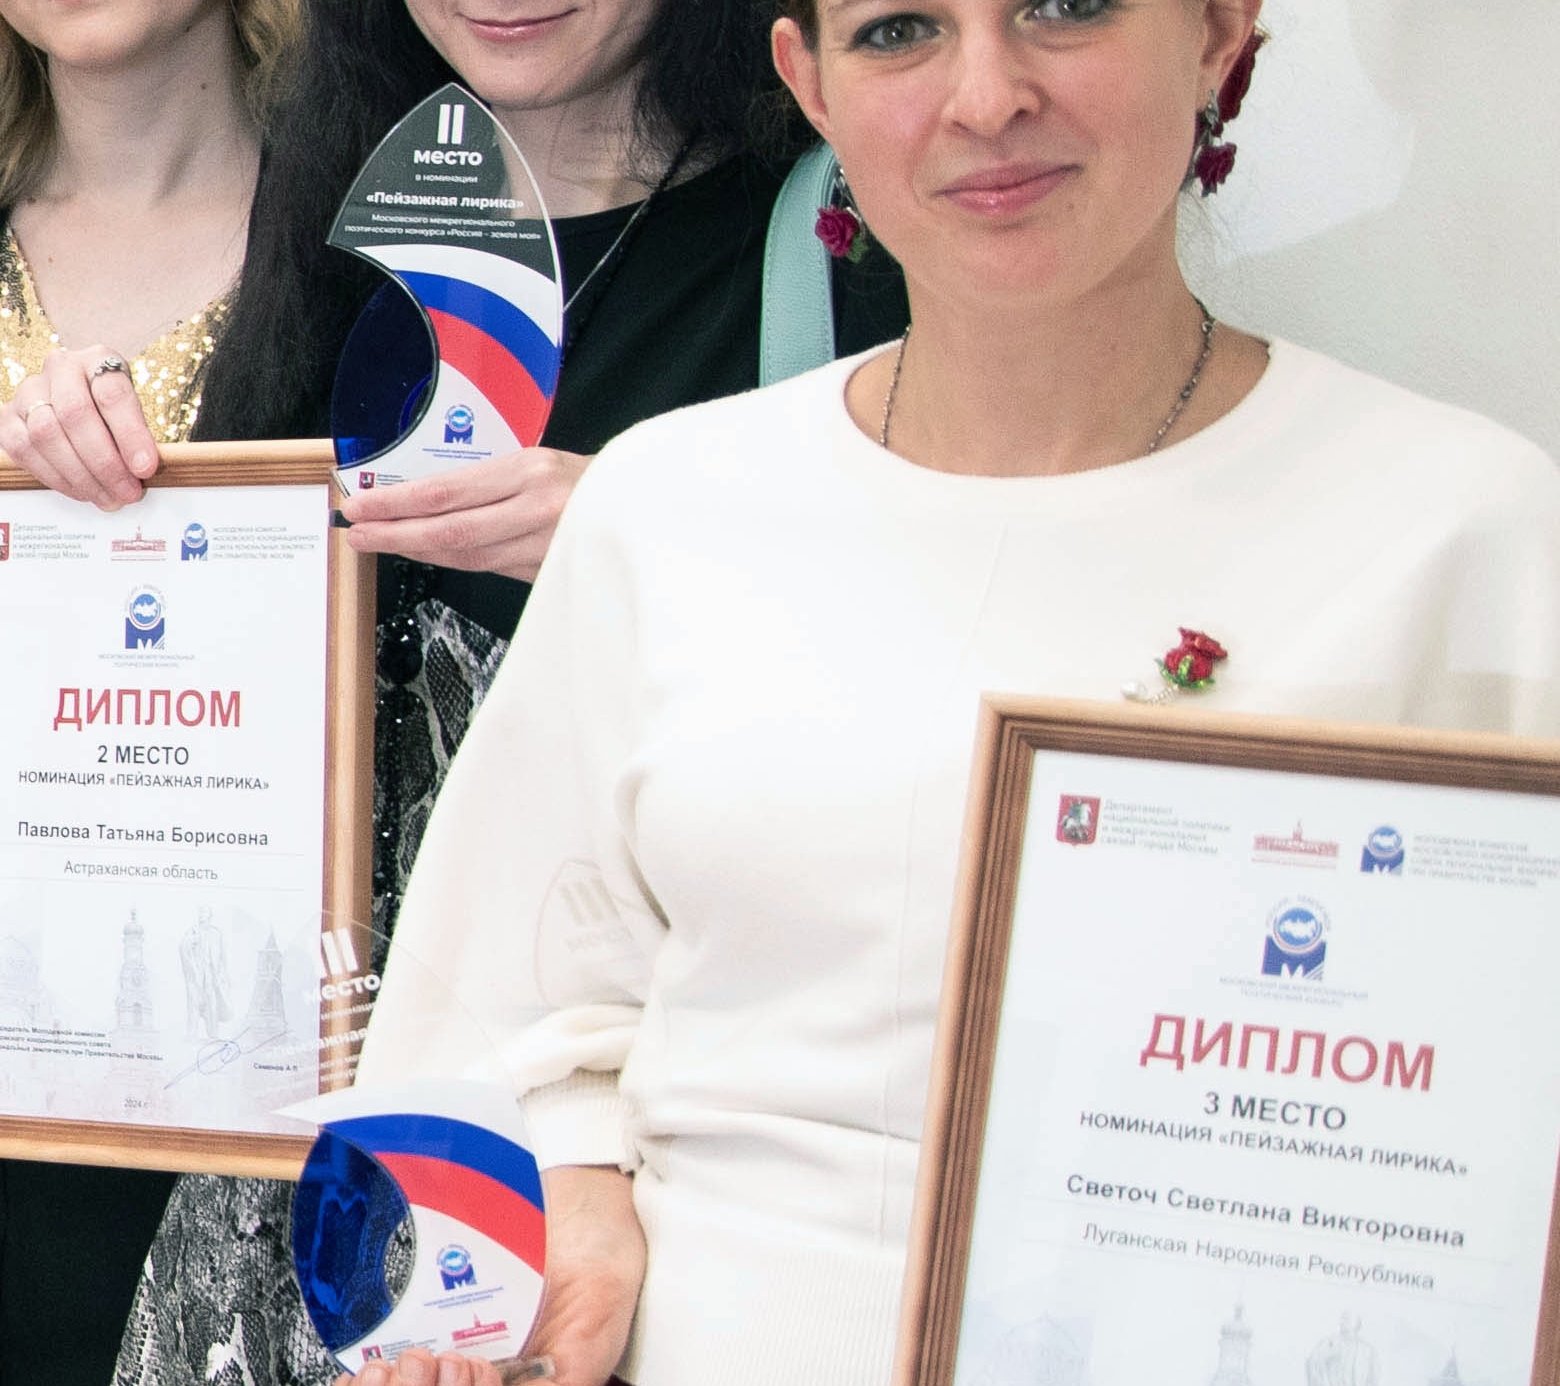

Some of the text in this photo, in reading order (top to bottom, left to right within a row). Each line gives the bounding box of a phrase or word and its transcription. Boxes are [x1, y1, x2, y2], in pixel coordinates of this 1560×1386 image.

[436, 103, 465, 145] II
[413, 149, 483, 166] место
[422, 174, 478, 184] номинации
[366, 191, 525, 211] «Пейзажная лирика»
[371, 213, 428, 224] Московского
[52, 687, 241, 732] ДИПЛОМ
[97, 744, 190, 766] 2 МЕСТО
[18, 770, 269, 790] НОМИНАЦИЯ «ПЕЙЗАЖНАЯ ЛИРИКА»
[18, 821, 269, 848] Павлова Татьяна Борисовна
[63, 860, 219, 880] Астраханская область
[1139, 1013, 1435, 1092] ДИПЛОМ
[1203, 1091, 1347, 1131] 3 МЕСТО
[1079, 1111, 1468, 1176] НОМИНАЦИЯ «ПЕЙЗАЖНАЯ ЛИРИКА»
[1066, 1174, 1465, 1248] Светоч Светлана Викторовна
[1082, 1221, 1435, 1292] Луганская Народная Республика
